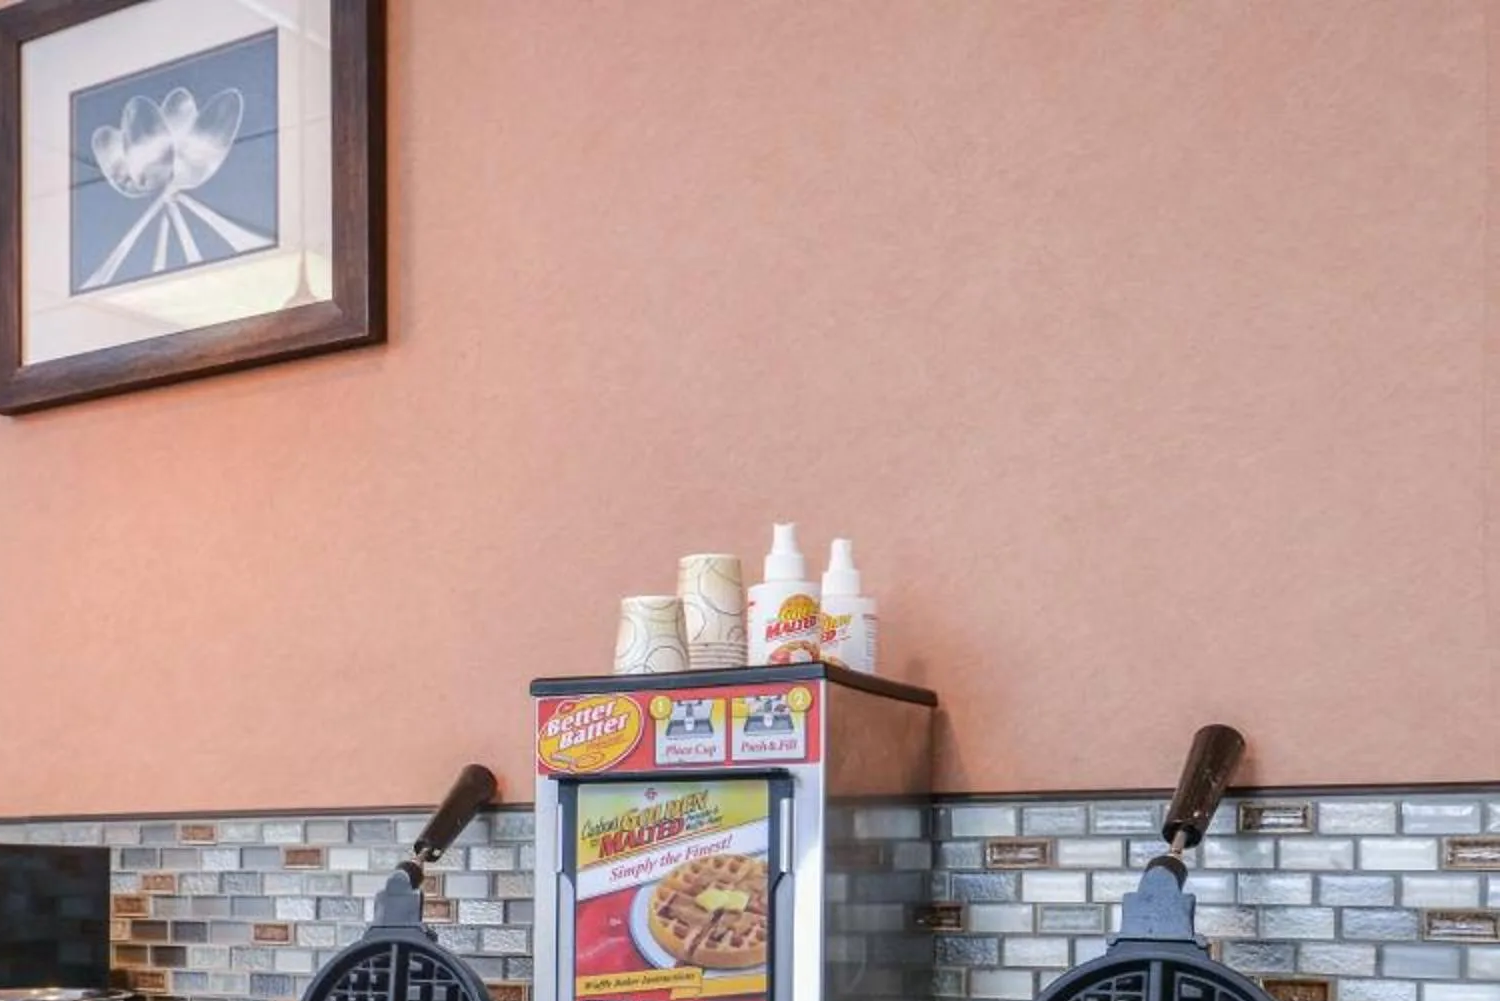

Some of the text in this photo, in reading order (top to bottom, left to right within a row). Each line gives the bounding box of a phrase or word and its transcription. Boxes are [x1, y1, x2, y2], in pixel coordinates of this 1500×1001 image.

[547, 700, 616, 737] Better
[560, 713, 629, 750] Batter
[695, 743, 717, 757] Cup
[599, 816, 684, 859] MALTED
[609, 833, 732, 881] Simply the Finest!
